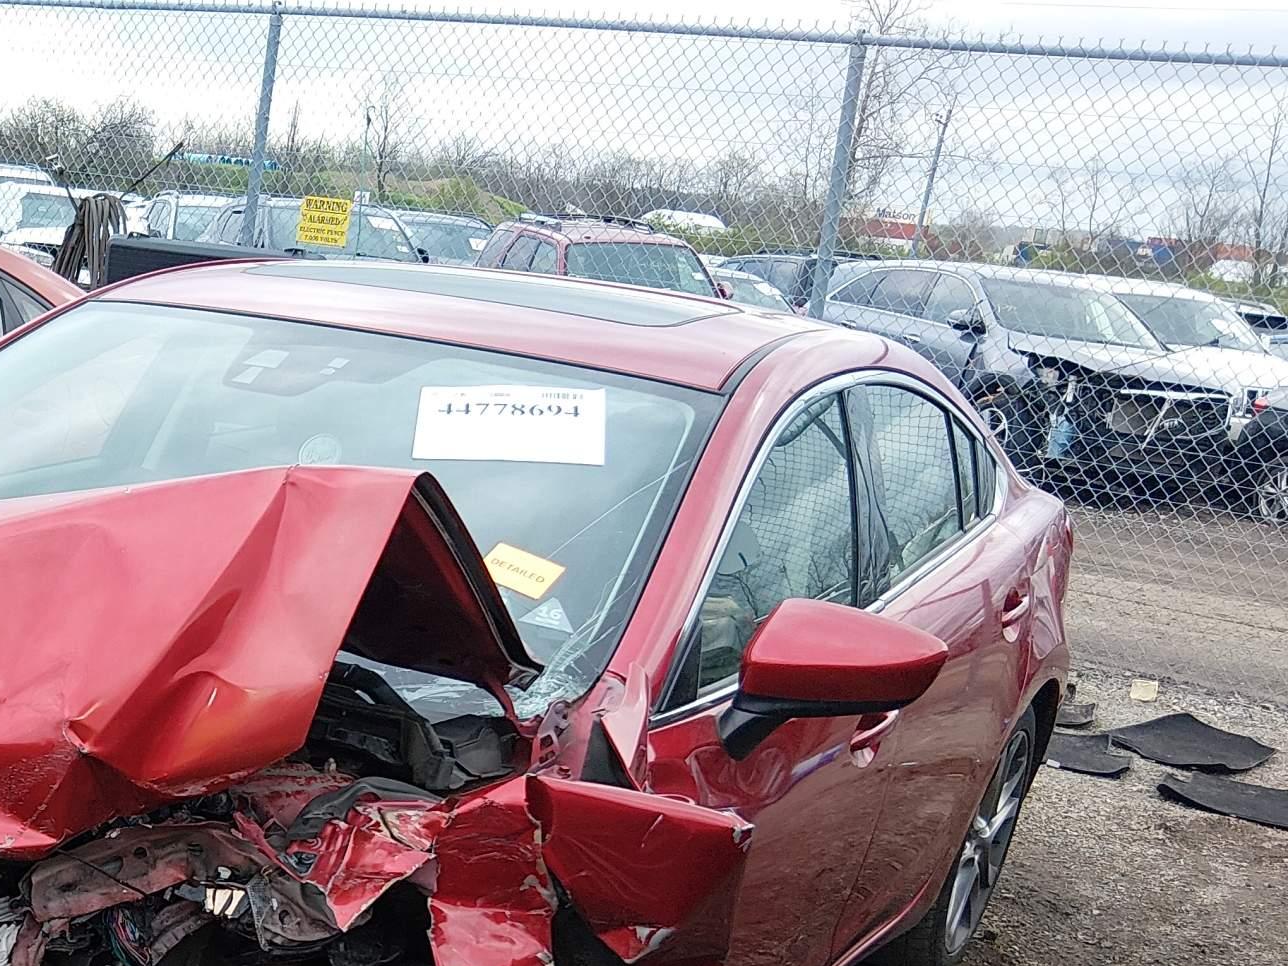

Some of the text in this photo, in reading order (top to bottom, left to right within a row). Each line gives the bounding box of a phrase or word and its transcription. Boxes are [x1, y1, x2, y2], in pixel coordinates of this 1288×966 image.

[305, 198, 348, 213] WARNING
[876, 206, 916, 220] Matson
[438, 402, 580, 418] 44778694
[490, 557, 545, 583] DETAILED
